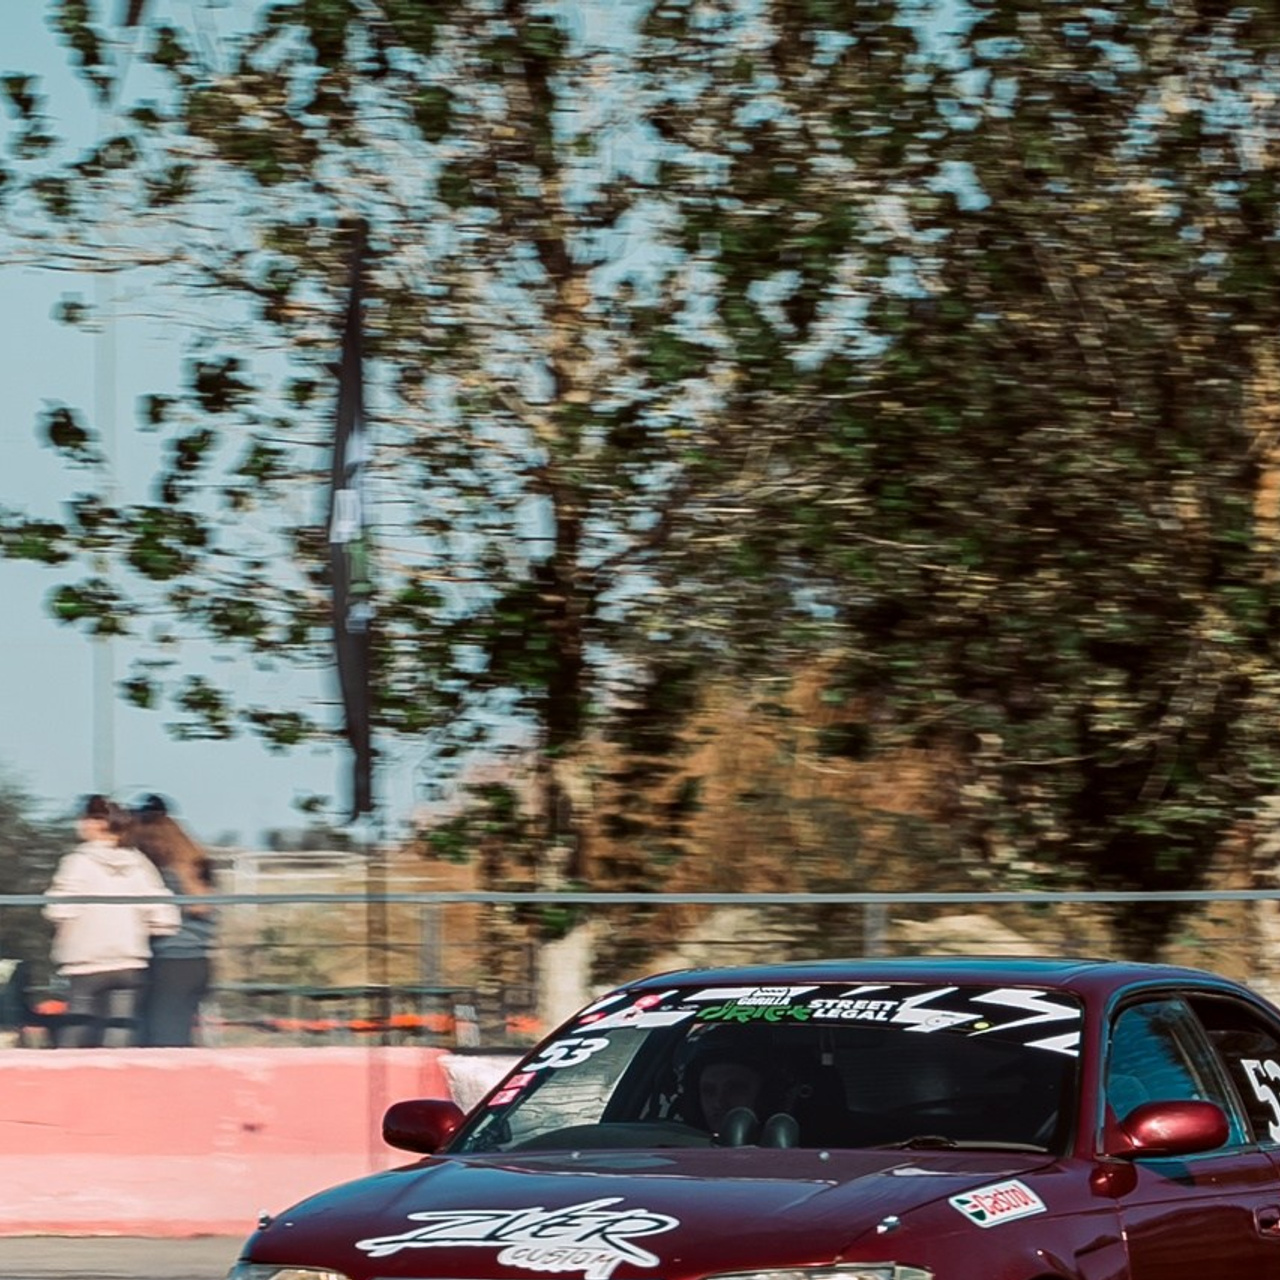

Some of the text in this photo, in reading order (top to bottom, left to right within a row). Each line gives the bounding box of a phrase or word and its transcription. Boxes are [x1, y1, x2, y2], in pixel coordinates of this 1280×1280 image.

[808, 999, 899, 1011] STREET
[811, 1008, 890, 1021] LEGAL
[521, 1038, 610, 1072] 53
[1240, 1059, 1280, 1144] 5
